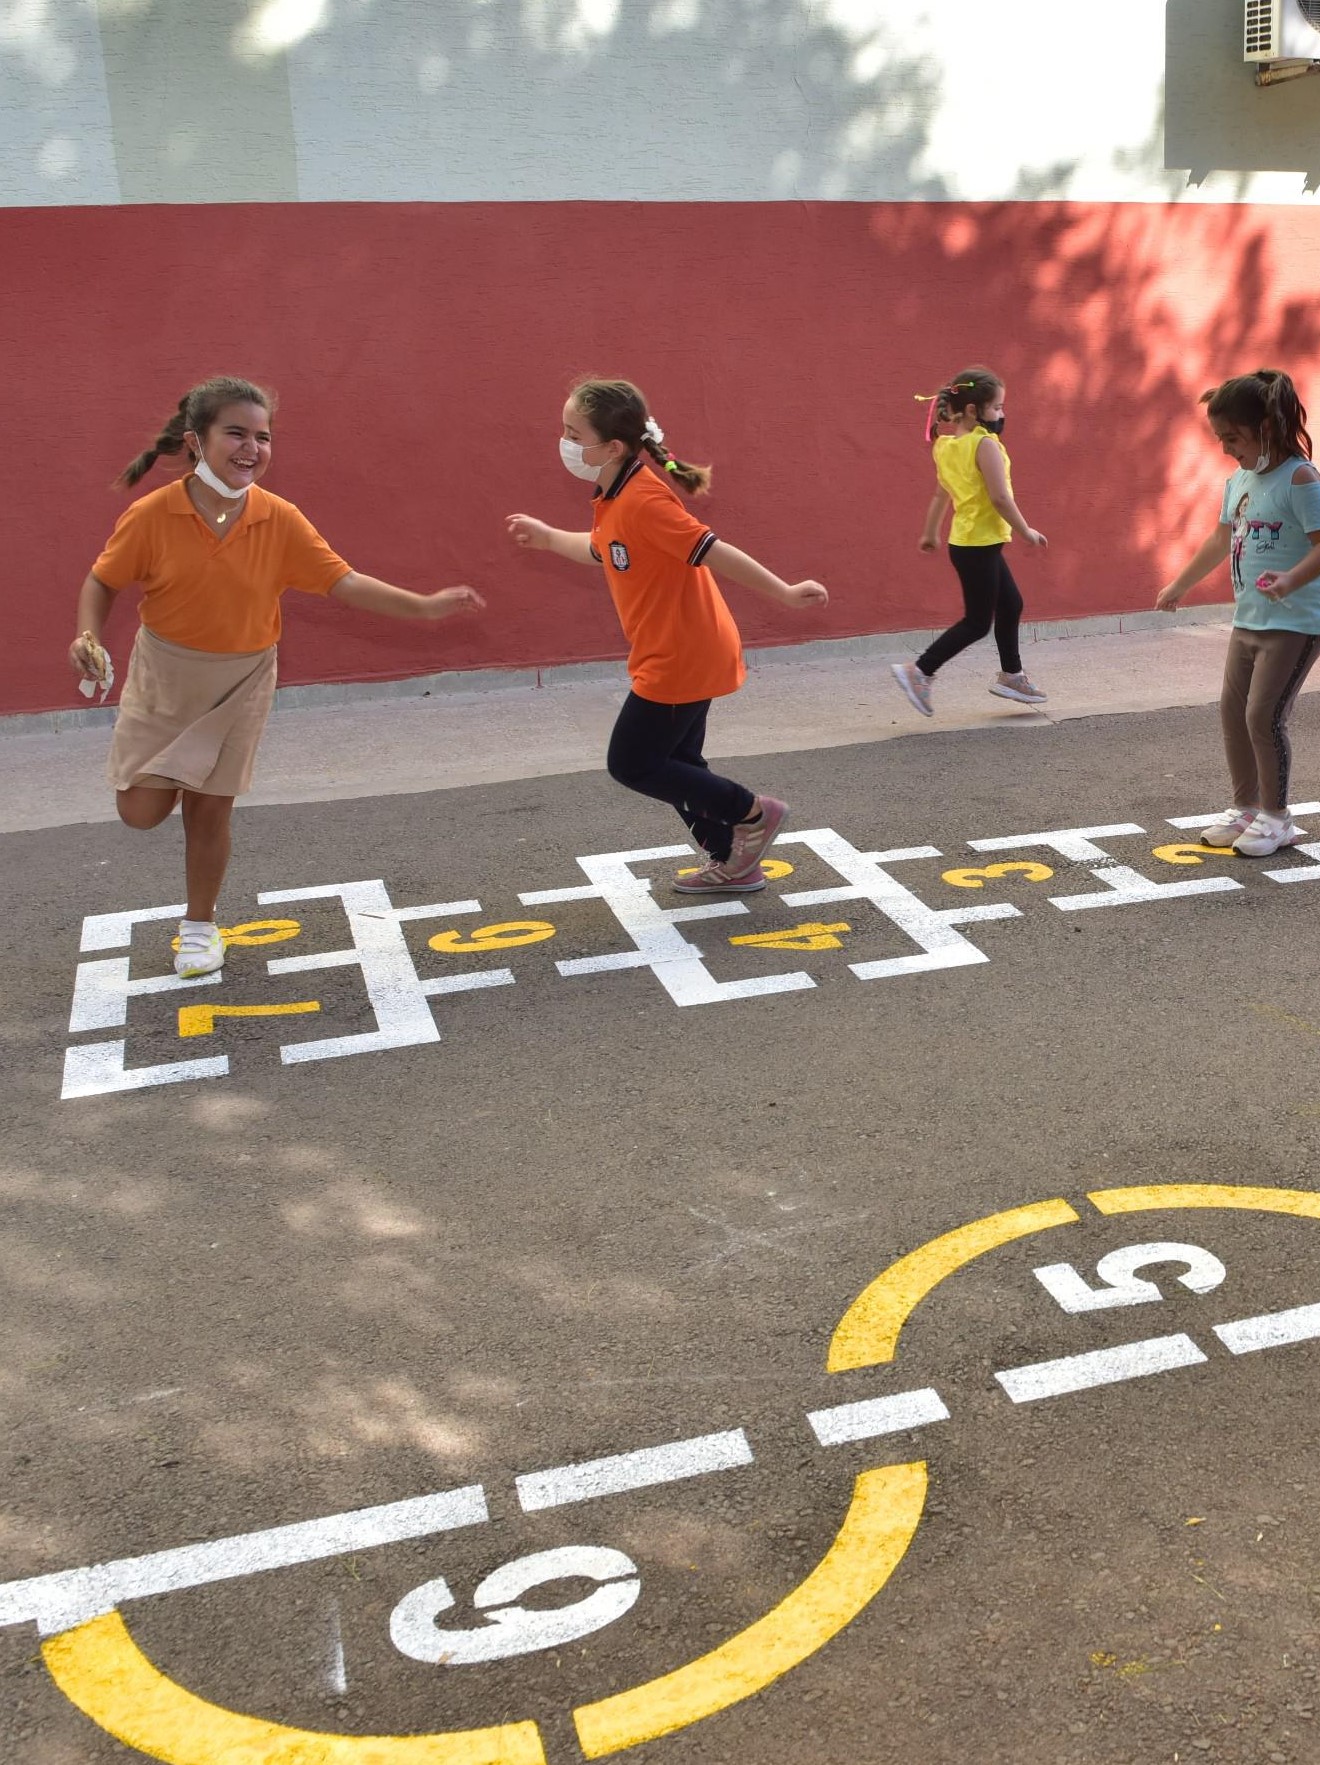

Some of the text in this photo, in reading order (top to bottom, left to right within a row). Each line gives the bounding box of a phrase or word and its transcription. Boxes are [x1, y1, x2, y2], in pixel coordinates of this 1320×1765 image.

[942, 861, 1054, 888] 3
[427, 920, 556, 953] 6
[729, 922, 851, 951] 4
[178, 1000, 321, 1038] 7
[1032, 1242, 1227, 1313] 5
[390, 1545, 641, 1664] 6
